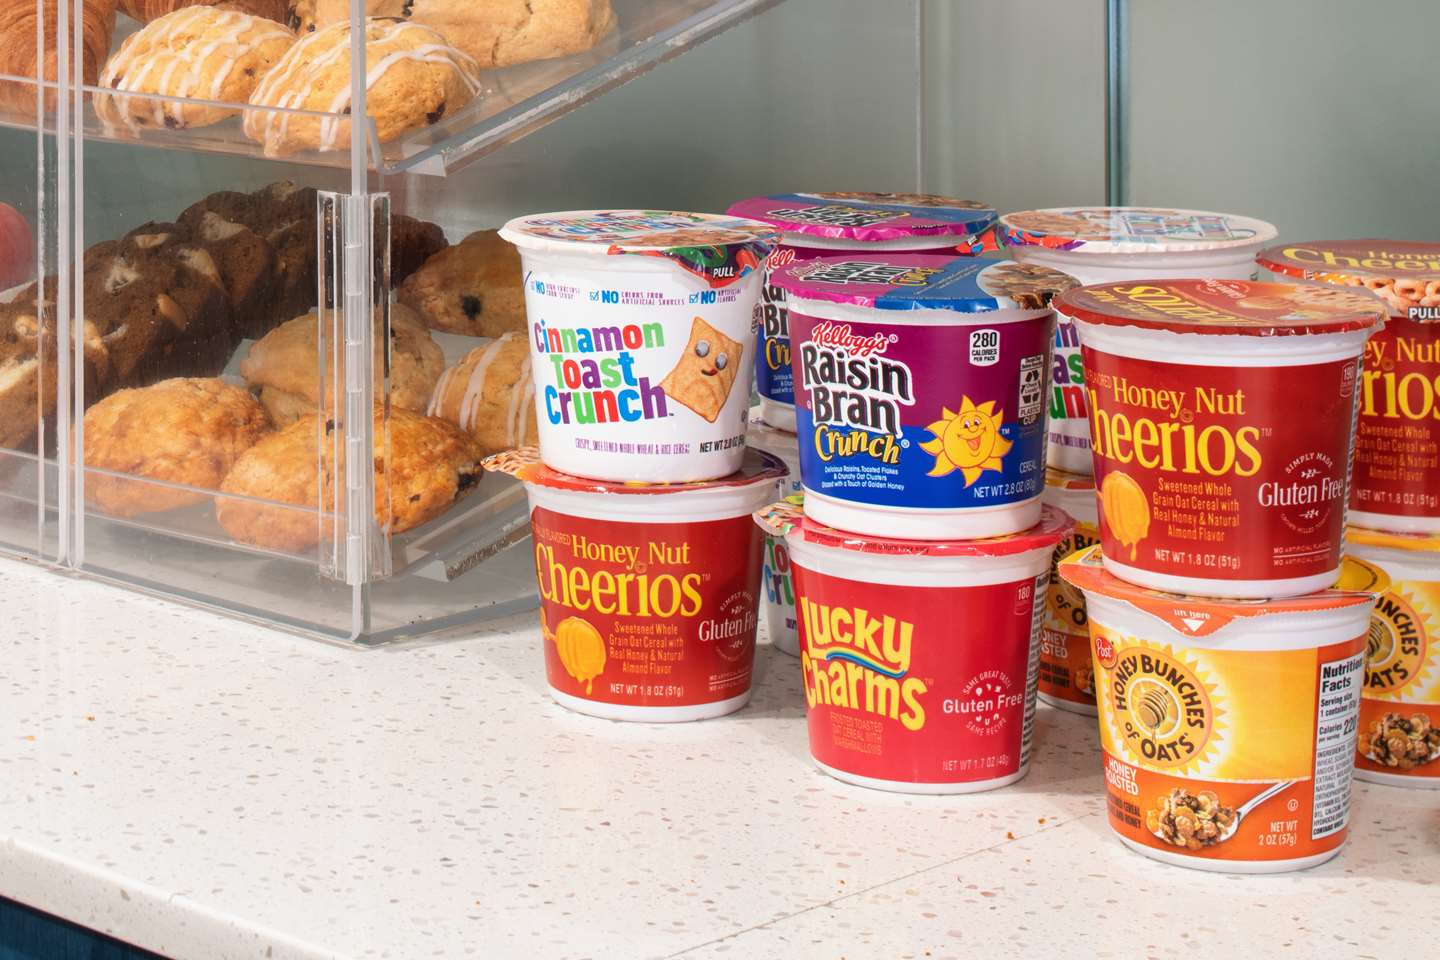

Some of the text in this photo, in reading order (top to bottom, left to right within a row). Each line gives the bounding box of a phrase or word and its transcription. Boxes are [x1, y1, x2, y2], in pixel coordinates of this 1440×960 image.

[713, 266, 734, 278] PULL
[535, 281, 545, 294] NO
[601, 290, 619, 303] NO
[701, 290, 716, 304] NO
[1409, 307, 1440, 320] PULL
[534, 319, 664, 353] Cinnamon
[811, 320, 890, 357] Kellogg's
[972, 331, 998, 348] 280
[971, 348, 998, 356] CALORIES
[549, 351, 637, 389] Toast
[801, 343, 913, 403] Raisin
[545, 376, 668, 425] Crunch
[1112, 376, 1185, 419] Honey
[1195, 386, 1246, 416] Nut
[813, 386, 900, 437] Bran
[1023, 415, 1038, 425] CUP
[1086, 385, 1263, 477] heerios
[1360, 423, 1431, 440] Sweetened Whole
[699, 440, 723, 453] NET WT
[814, 423, 901, 465] Crunch
[1392, 439, 1419, 454] Cereal
[1284, 451, 1315, 474] SIMPLY
[974, 483, 1015, 498] NET WT 2.8
[1158, 477, 1232, 496] Sweetened Whole
[1258, 477, 1344, 507] Gluten Free
[1153, 491, 1240, 512] Grain Oat Cereal with
[1373, 490, 1386, 502] WT
[1388, 492, 1402, 504] 1.8
[1403, 493, 1415, 505] OZ
[1153, 507, 1240, 528] Real Honey & Natural
[1167, 524, 1225, 542] Almond Flavor
[571, 534, 690, 570] Honey Nut
[1155, 548, 1241, 570] NET WT 1.8 OZ (51g)
[536, 542, 703, 618] Cheerios
[1017, 586, 1030, 601] 180
[614, 621, 679, 636] Sweetened Whole
[699, 619, 743, 642] Gluten
[800, 597, 914, 672] Lucky
[609, 634, 684, 649] Grain Oat Cereal with
[1096, 638, 1112, 659] Post
[610, 647, 684, 663] Real Honey Natural
[622, 661, 673, 675] Almond Flavor
[610, 683, 684, 697] NET WT 1.8 OZ (51g)
[802, 650, 928, 731] Charms
[962, 670, 999, 696] SAME GREAT
[1114, 655, 1138, 711] HONEY
[1140, 654, 1205, 729] BUNCHES
[1322, 675, 1351, 693] Facts
[943, 693, 1023, 715] Gluten Free
[1320, 692, 1353, 708] Serving size
[965, 717, 1007, 737] SAME RECIPE
[1319, 716, 1357, 736] Calories 220
[1125, 721, 1194, 762] of OATS
[943, 758, 973, 772] NET WT
[1109, 757, 1137, 781] HONEY
[1106, 767, 1139, 796] ROASTED
[1270, 820, 1298, 832] NET WT
[1258, 833, 1297, 847] 2 OZ (57g)
